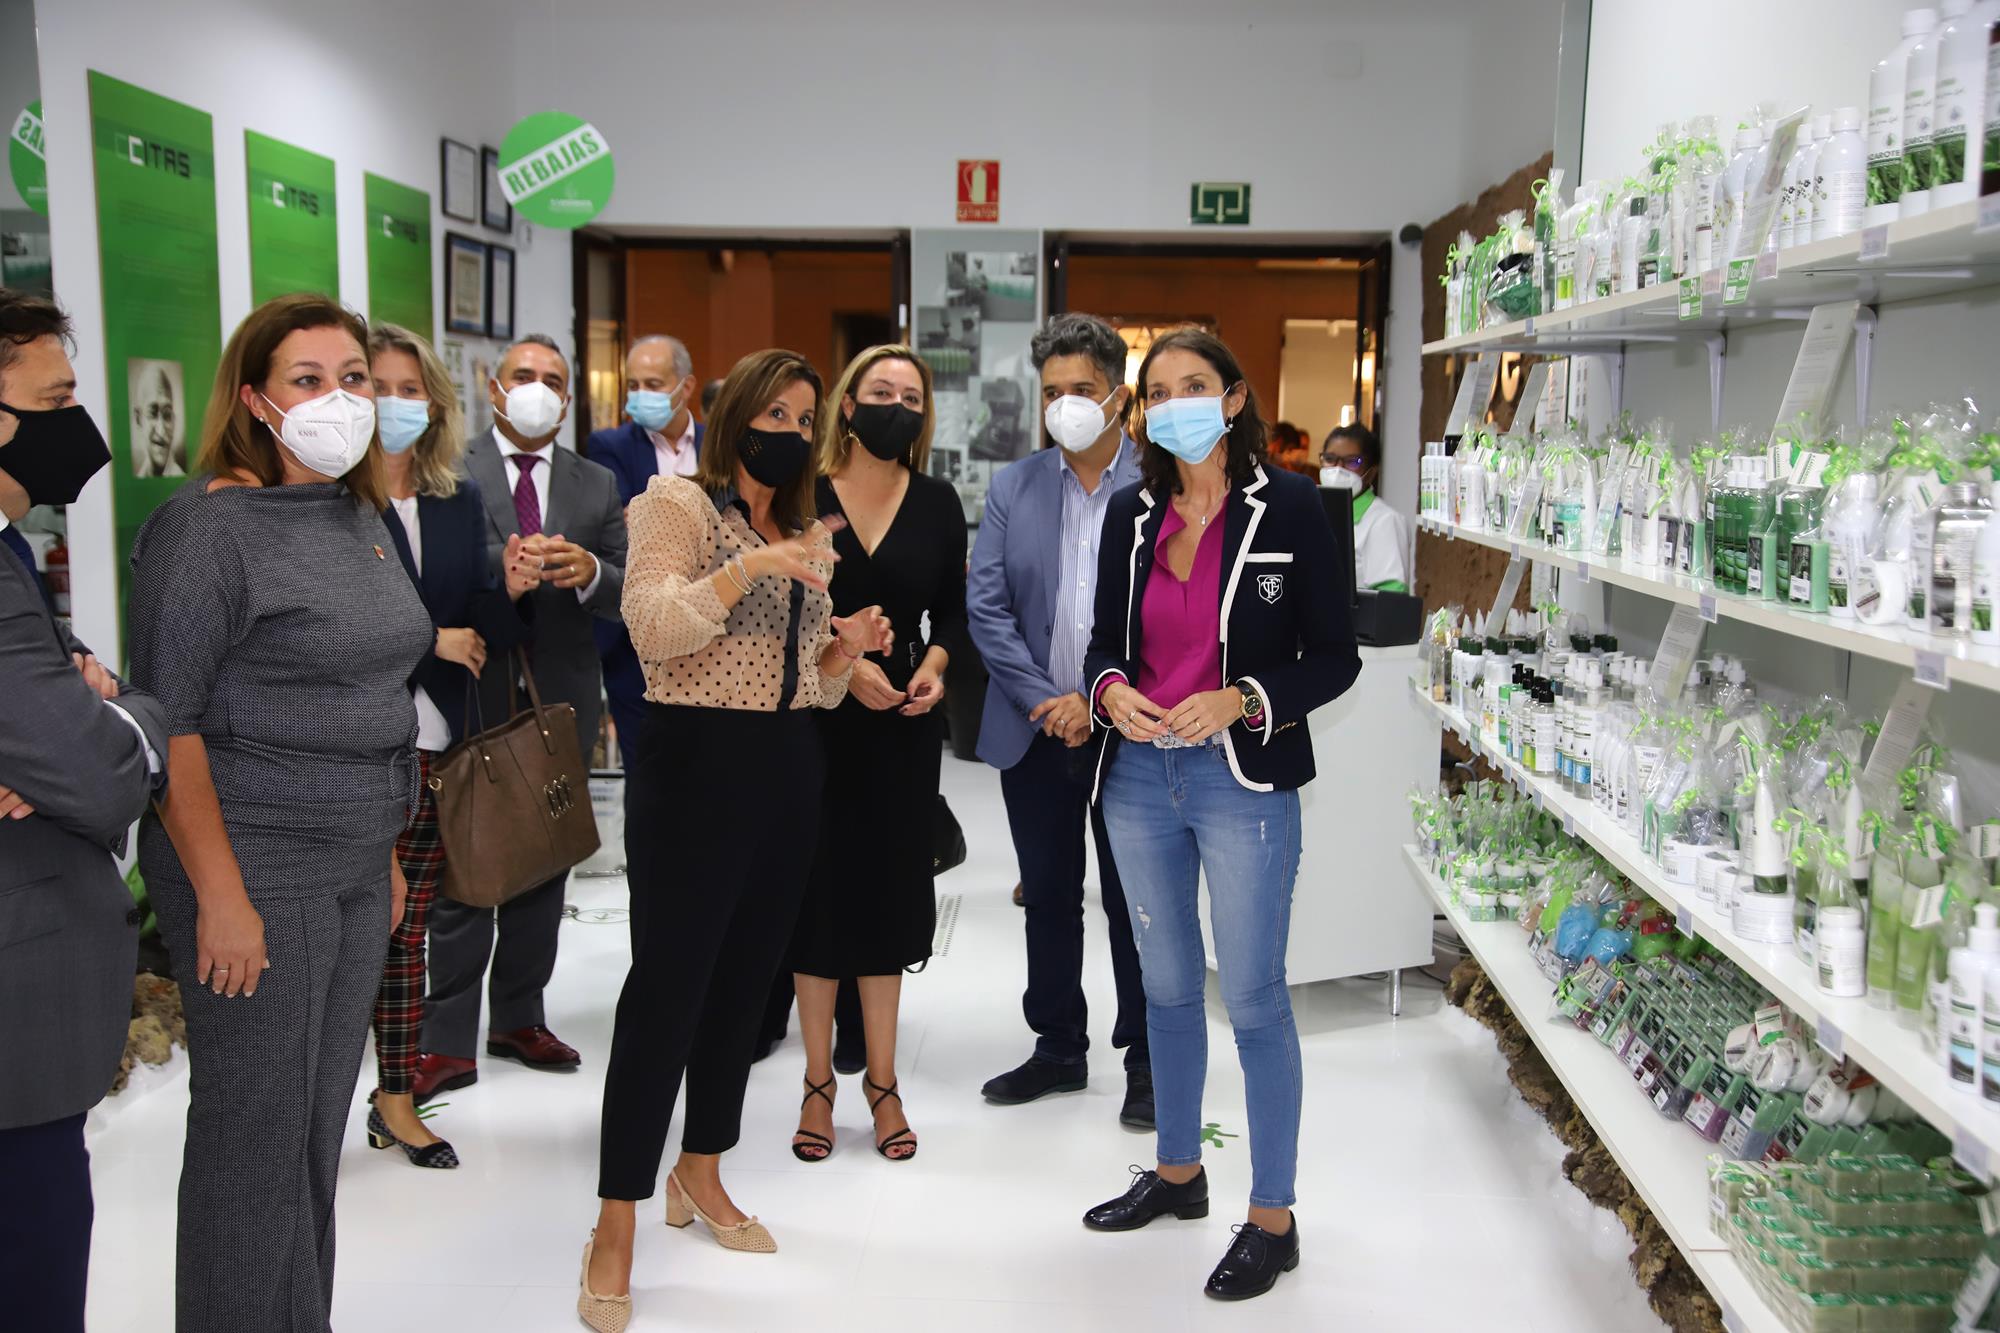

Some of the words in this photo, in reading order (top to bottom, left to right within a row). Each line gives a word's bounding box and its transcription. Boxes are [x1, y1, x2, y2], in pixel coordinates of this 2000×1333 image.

[128, 135, 191, 178] CITAS
[506, 132, 600, 195] REBAJAS
[272, 181, 319, 216] CITAS
